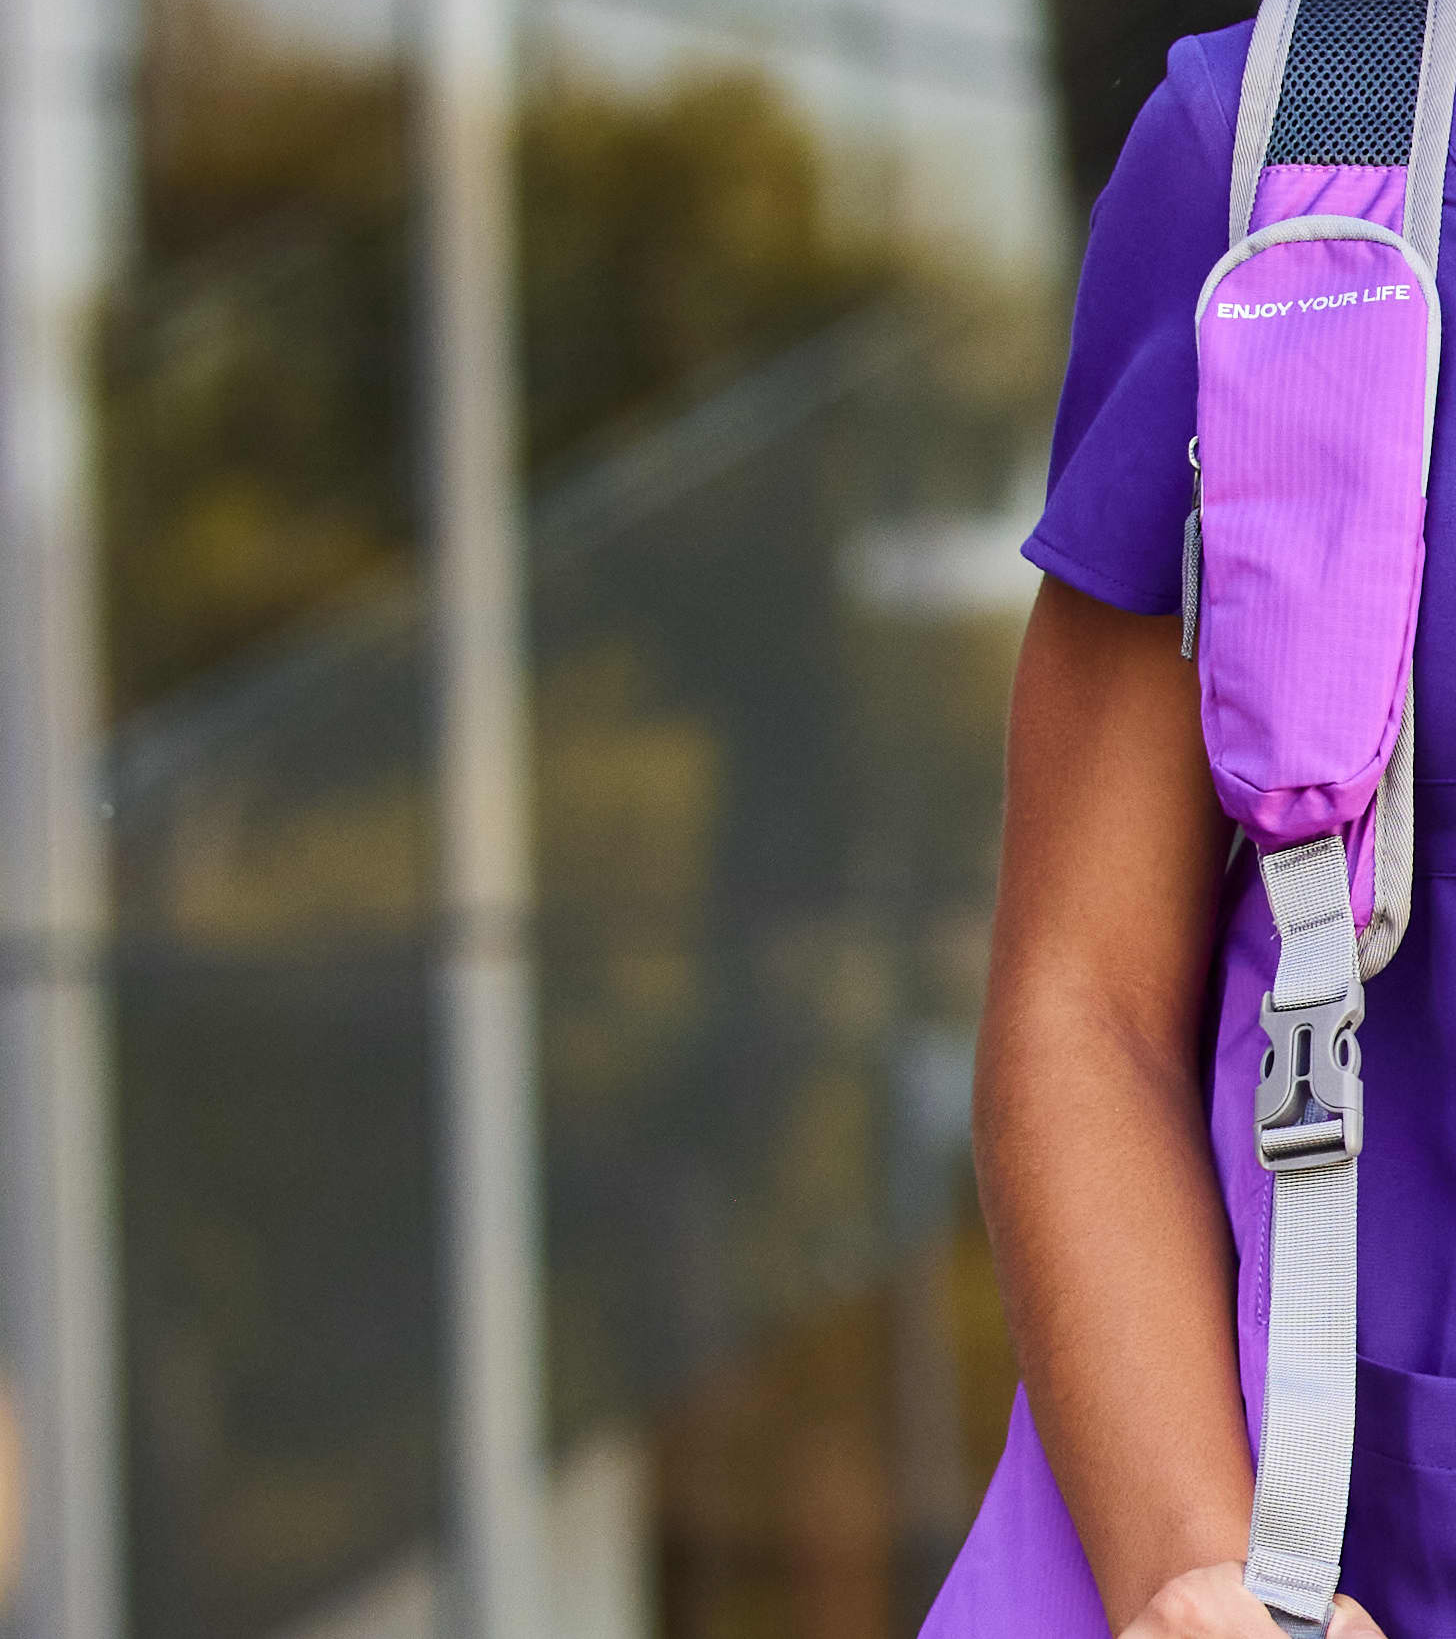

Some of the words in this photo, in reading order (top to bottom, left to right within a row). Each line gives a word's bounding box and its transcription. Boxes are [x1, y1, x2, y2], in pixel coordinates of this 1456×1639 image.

[1217, 301, 1293, 319] ENJOY
[1298, 292, 1357, 312] YOUR
[1363, 285, 1410, 302] LIFE
